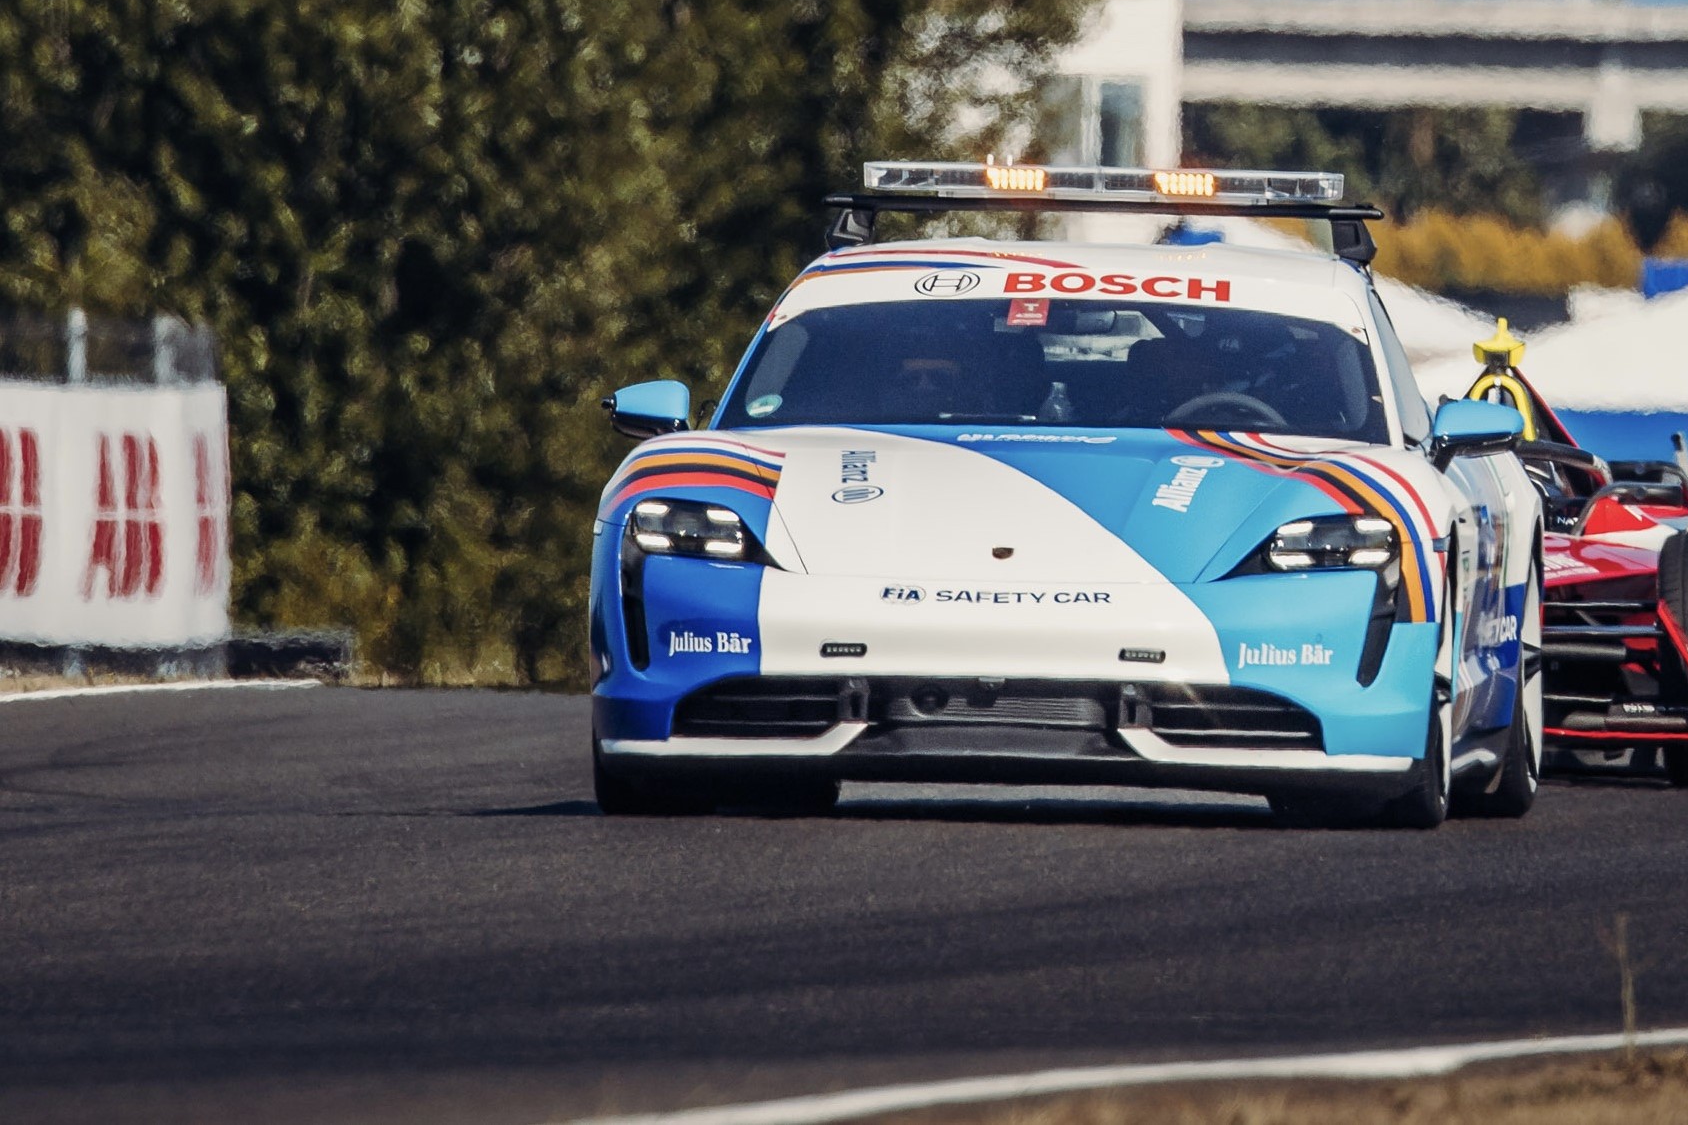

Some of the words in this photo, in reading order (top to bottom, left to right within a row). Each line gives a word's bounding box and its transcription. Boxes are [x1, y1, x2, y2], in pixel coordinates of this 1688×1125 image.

[1003, 272, 1231, 302] BOSCH
[841, 450, 876, 483] Allianz
[1152, 466, 1208, 513] Allianz
[935, 589, 1047, 604] SAFETY
[1053, 591, 1112, 604] CAR
[668, 631, 713, 657] Julius
[716, 631, 752, 654] Bär
[1238, 643, 1297, 669] Julius
[1301, 644, 1334, 665] Bär
